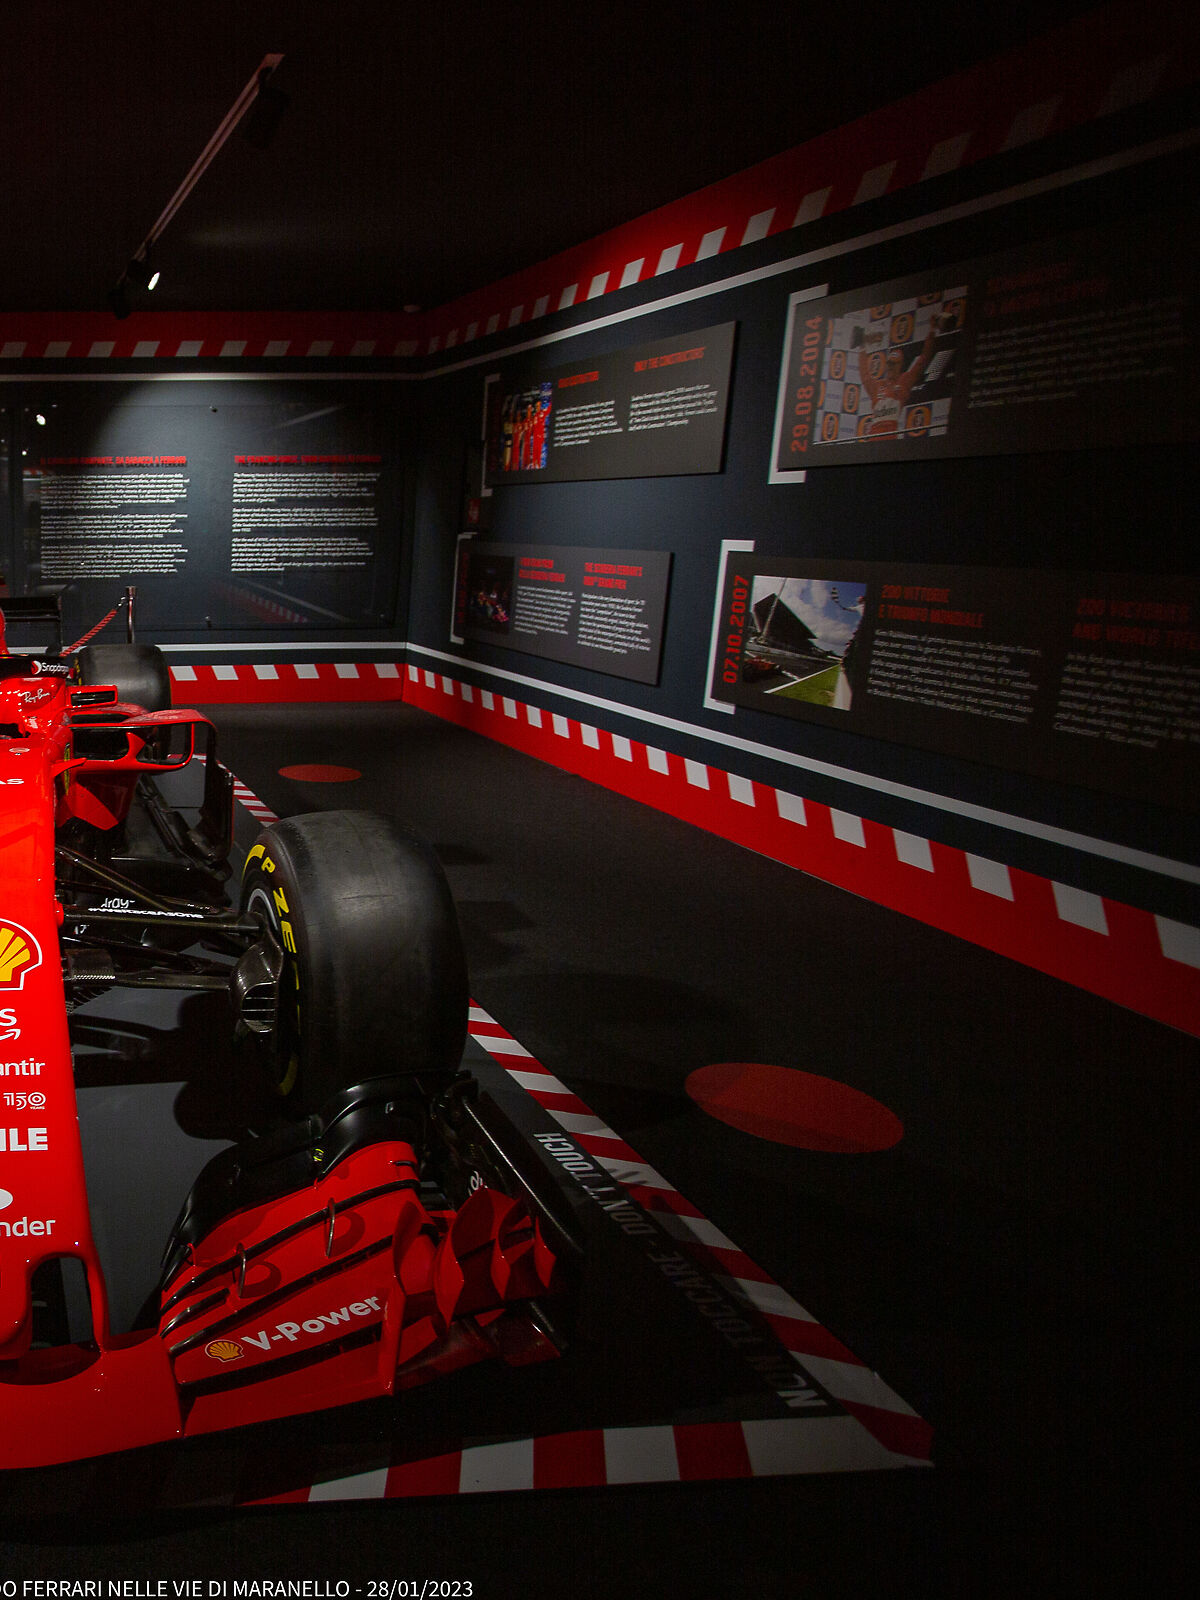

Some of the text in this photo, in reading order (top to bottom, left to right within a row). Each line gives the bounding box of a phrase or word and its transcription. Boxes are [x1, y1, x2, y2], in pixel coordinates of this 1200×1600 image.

[790, 315, 823, 453] 29.08.2004
[723, 575, 749, 683] 07.10.2007
[19, 688, 50, 704] Ray-Ban
[261, 856, 276, 875] P
[3, 1092, 46, 1110] 150
[532, 1131, 604, 1182] TOUCH
[241, 1294, 381, 1353] V-Power
